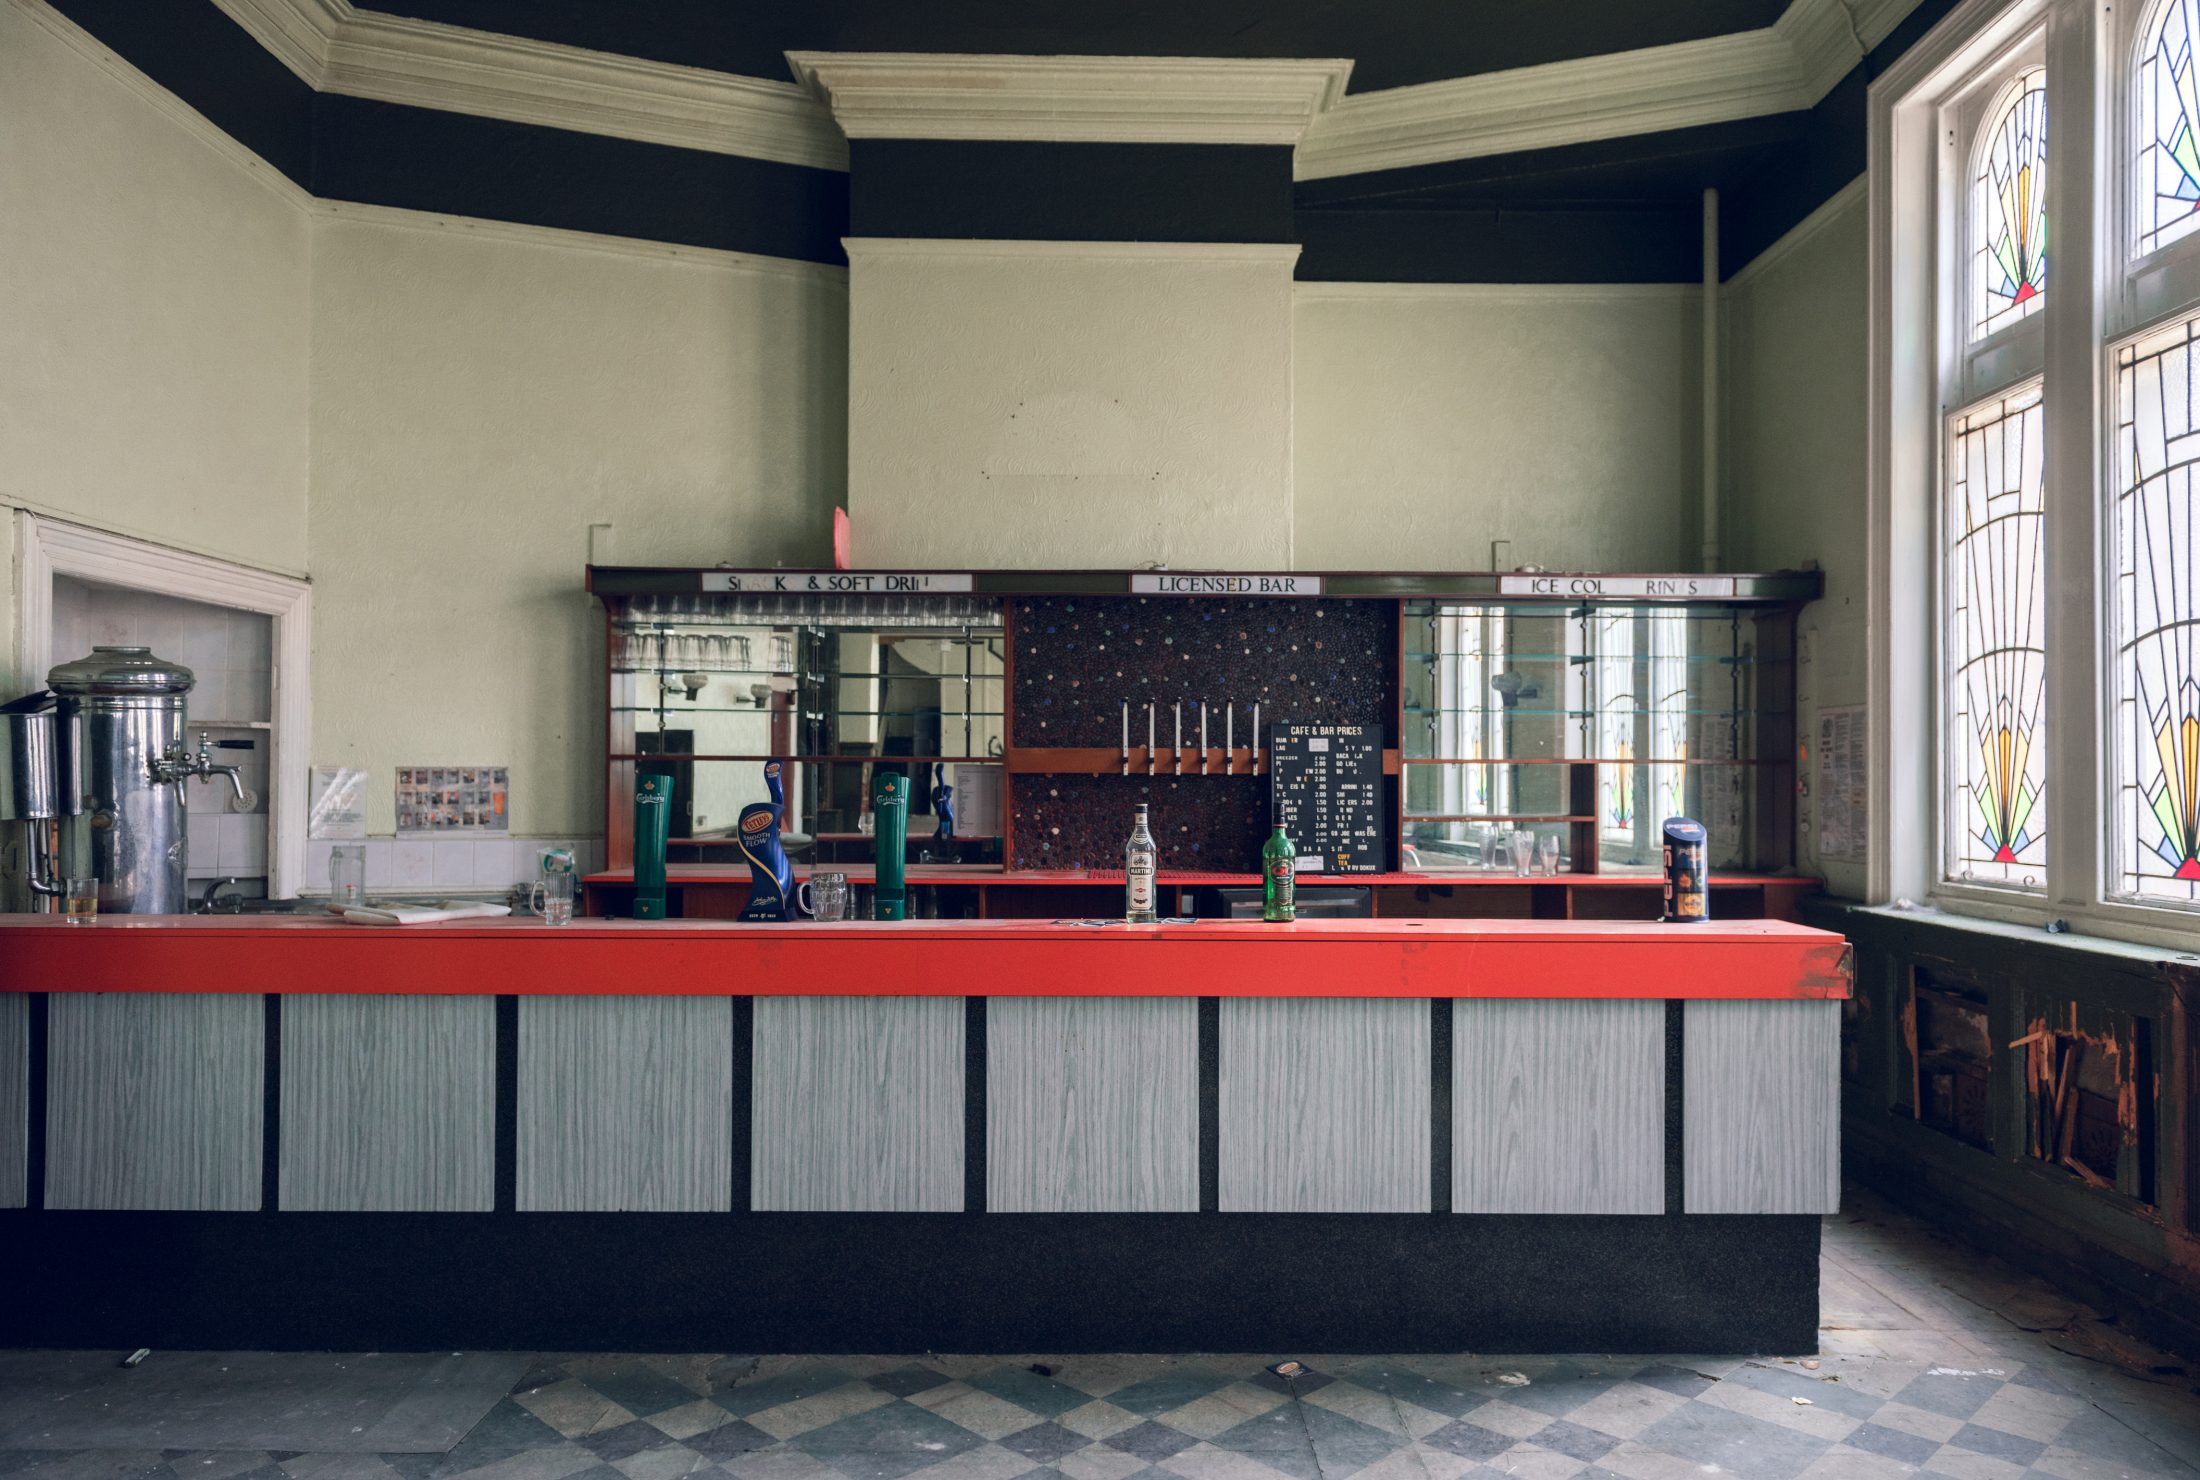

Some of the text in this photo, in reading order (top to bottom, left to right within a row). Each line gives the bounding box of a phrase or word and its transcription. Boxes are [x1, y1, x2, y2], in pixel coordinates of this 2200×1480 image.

[808, 577, 820, 590] &
[828, 576, 874, 590] SOFT
[1159, 577, 1296, 592] LICENSED BAR
[1532, 579, 1558, 593] ICE
[1291, 726, 1362, 735] CAFE & BAR PRICES
[746, 839, 768, 847] FLOW
[1664, 845, 1673, 917] PEPSI
